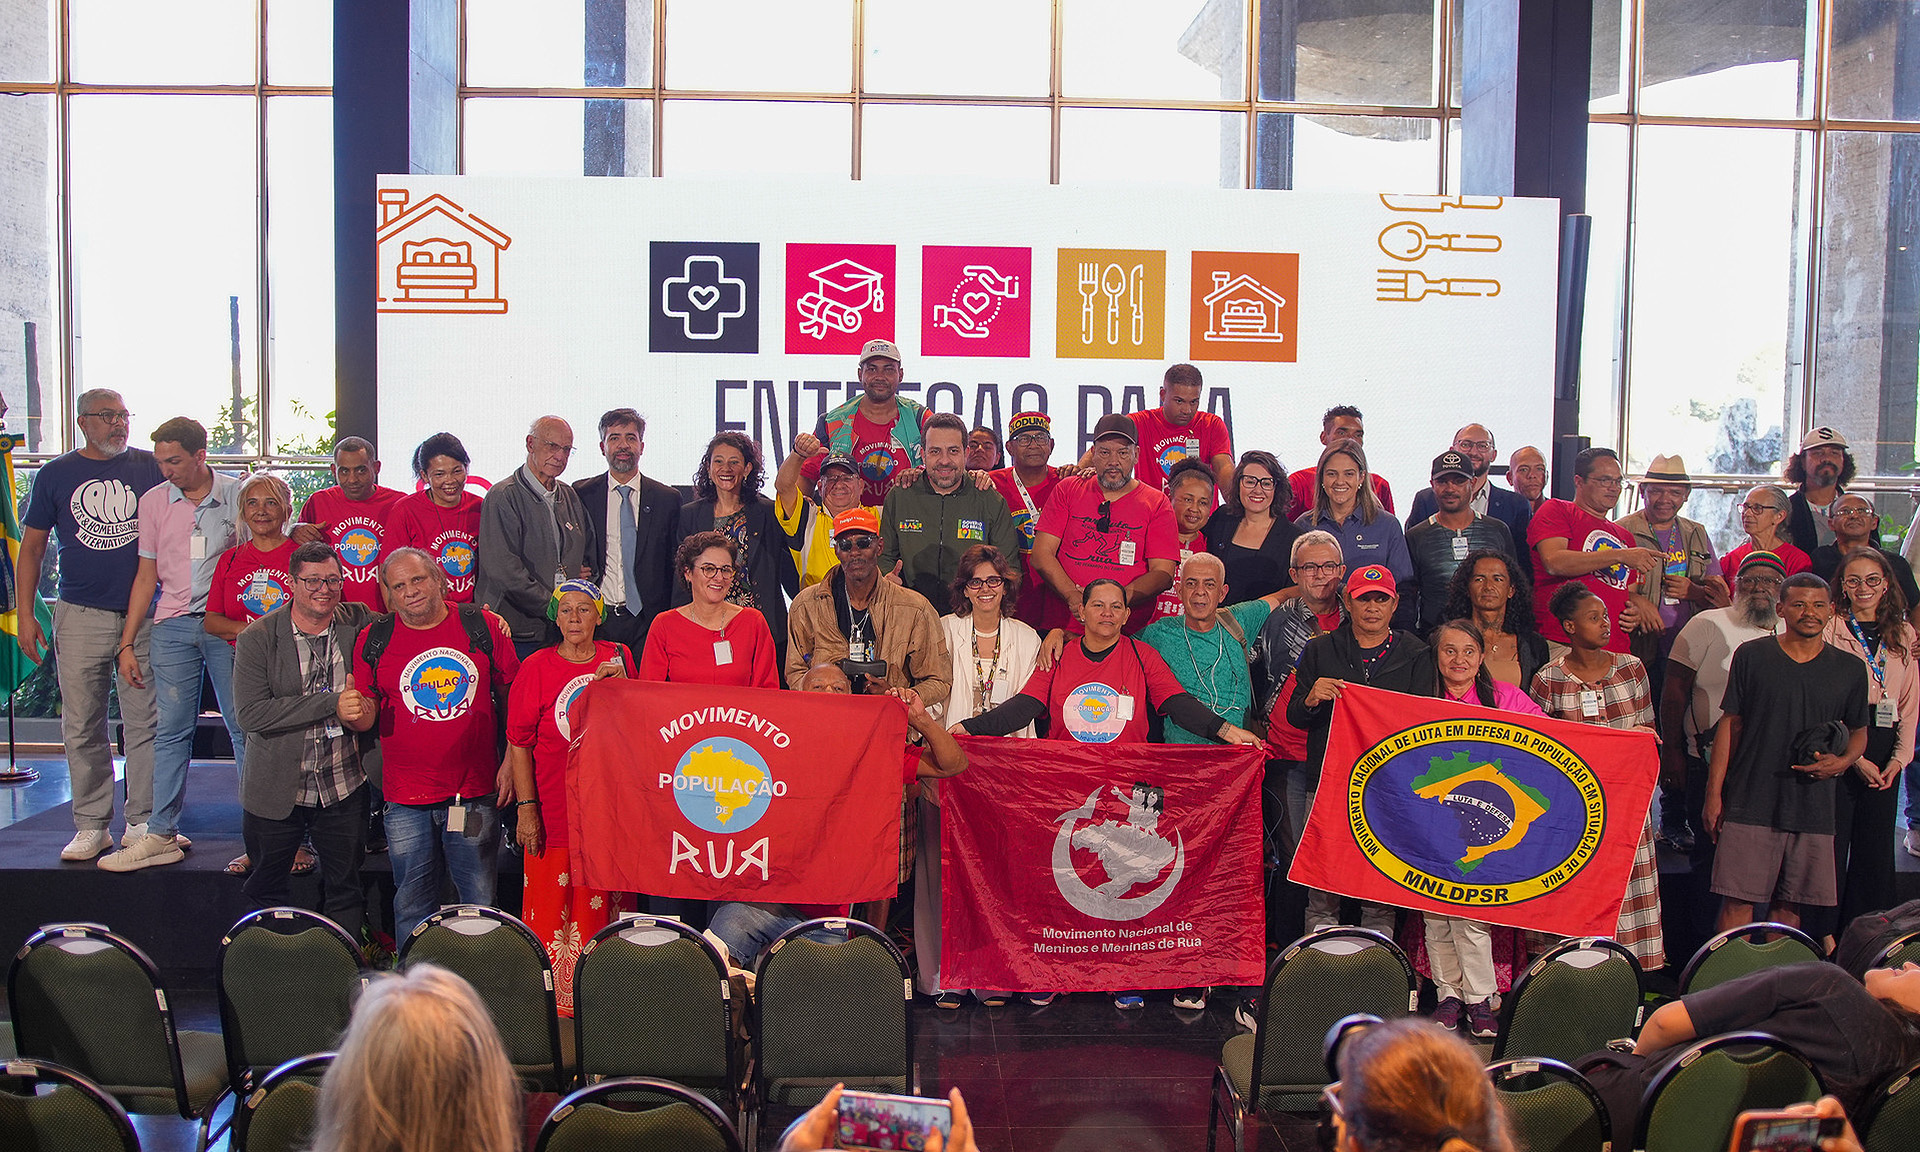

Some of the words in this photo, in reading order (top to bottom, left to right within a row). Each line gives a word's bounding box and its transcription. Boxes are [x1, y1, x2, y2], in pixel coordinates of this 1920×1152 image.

[86, 520, 139, 535] HOMELESSNE
[403, 649, 438, 679] MOVIMENTO
[439, 649, 471, 669] NACIONAL
[403, 673, 477, 693] POPULAÇÃO
[658, 705, 791, 749] MOVIMENTO
[1412, 727, 1443, 744] LUTA
[1445, 724, 1464, 737] EM
[1467, 725, 1510, 741] DEFESA
[1394, 735, 1411, 750] DE
[1513, 731, 1529, 746] DA
[1352, 744, 1395, 788] NACIONAL
[1530, 737, 1590, 784] POPULAÇÃO
[658, 771, 788, 799] POPULAÇÃO
[1582, 782, 1599, 802] EM
[715, 805, 730, 816] DE
[1453, 794, 1474, 805] LUTA
[1484, 803, 1512, 826] DEFESA
[1350, 791, 1381, 857] MOVIMENTO
[1579, 801, 1601, 858] SITUAÇÃO
[669, 830, 770, 882] RUA
[1564, 859, 1580, 875] DE
[1402, 869, 1510, 903] MNLDPSR
[1541, 869, 1566, 889] RUA
[1042, 927, 1116, 940] Movimento
[1118, 921, 1174, 939] Nacional
[1176, 920, 1193, 932] de
[1033, 942, 1089, 954] Meninos
[1090, 944, 1099, 953] e
[1101, 940, 1156, 953] Meninas
[1157, 937, 1175, 949] de
[1176, 937, 1202, 949] Rua
